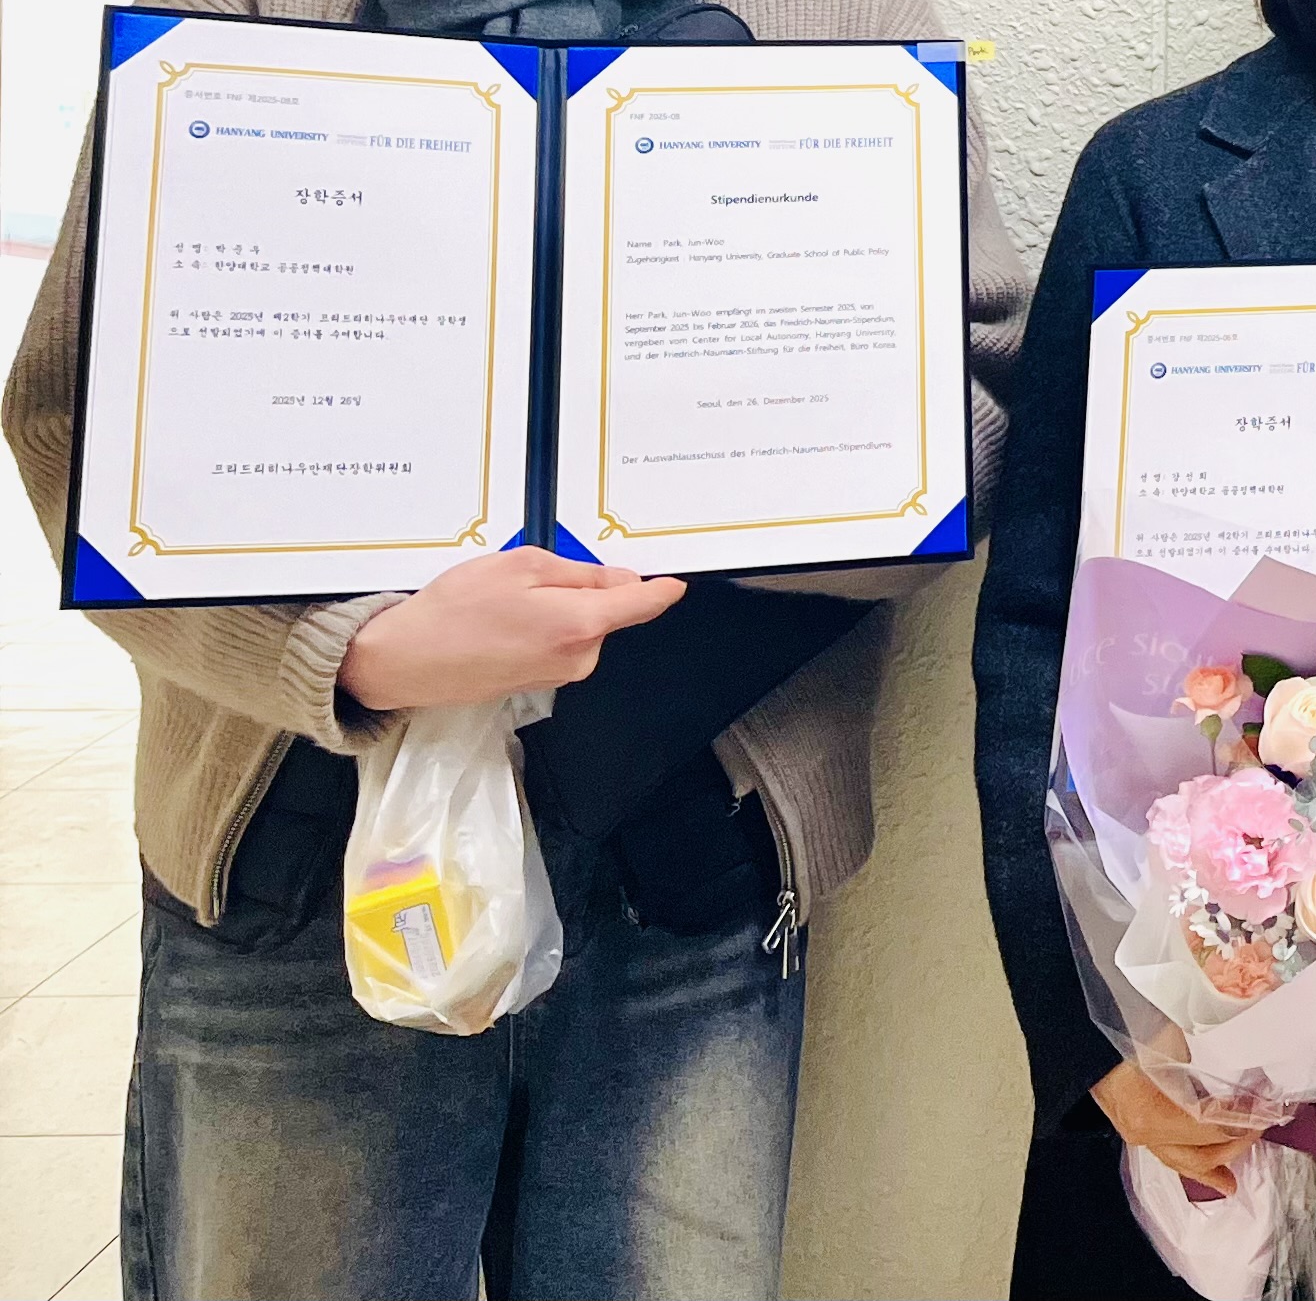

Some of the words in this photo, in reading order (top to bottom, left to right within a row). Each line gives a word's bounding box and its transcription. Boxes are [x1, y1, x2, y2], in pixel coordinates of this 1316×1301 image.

[215, 126, 266, 138] HANYANG
[269, 129, 328, 141] UNIVERSITY
[368, 134, 392, 148] FÜR
[395, 136, 415, 149] DIE
[418, 138, 472, 152] FREIHEIT
[658, 140, 704, 149] HANYANG
[707, 139, 761, 149] UNIVERSITY
[799, 136, 819, 149] FÜR
[823, 137, 841, 148] DIE
[844, 136, 893, 148] FREIHEIT
[295, 187, 362, 206] 장학증서
[710, 192, 818, 206] Stipendienurkunde
[1170, 365, 1211, 374] HANYANG
[1213, 364, 1262, 373] UNIVERSITY
[1296, 360, 1315, 373] FÜR
[1234, 414, 1291, 432] 장학증서
